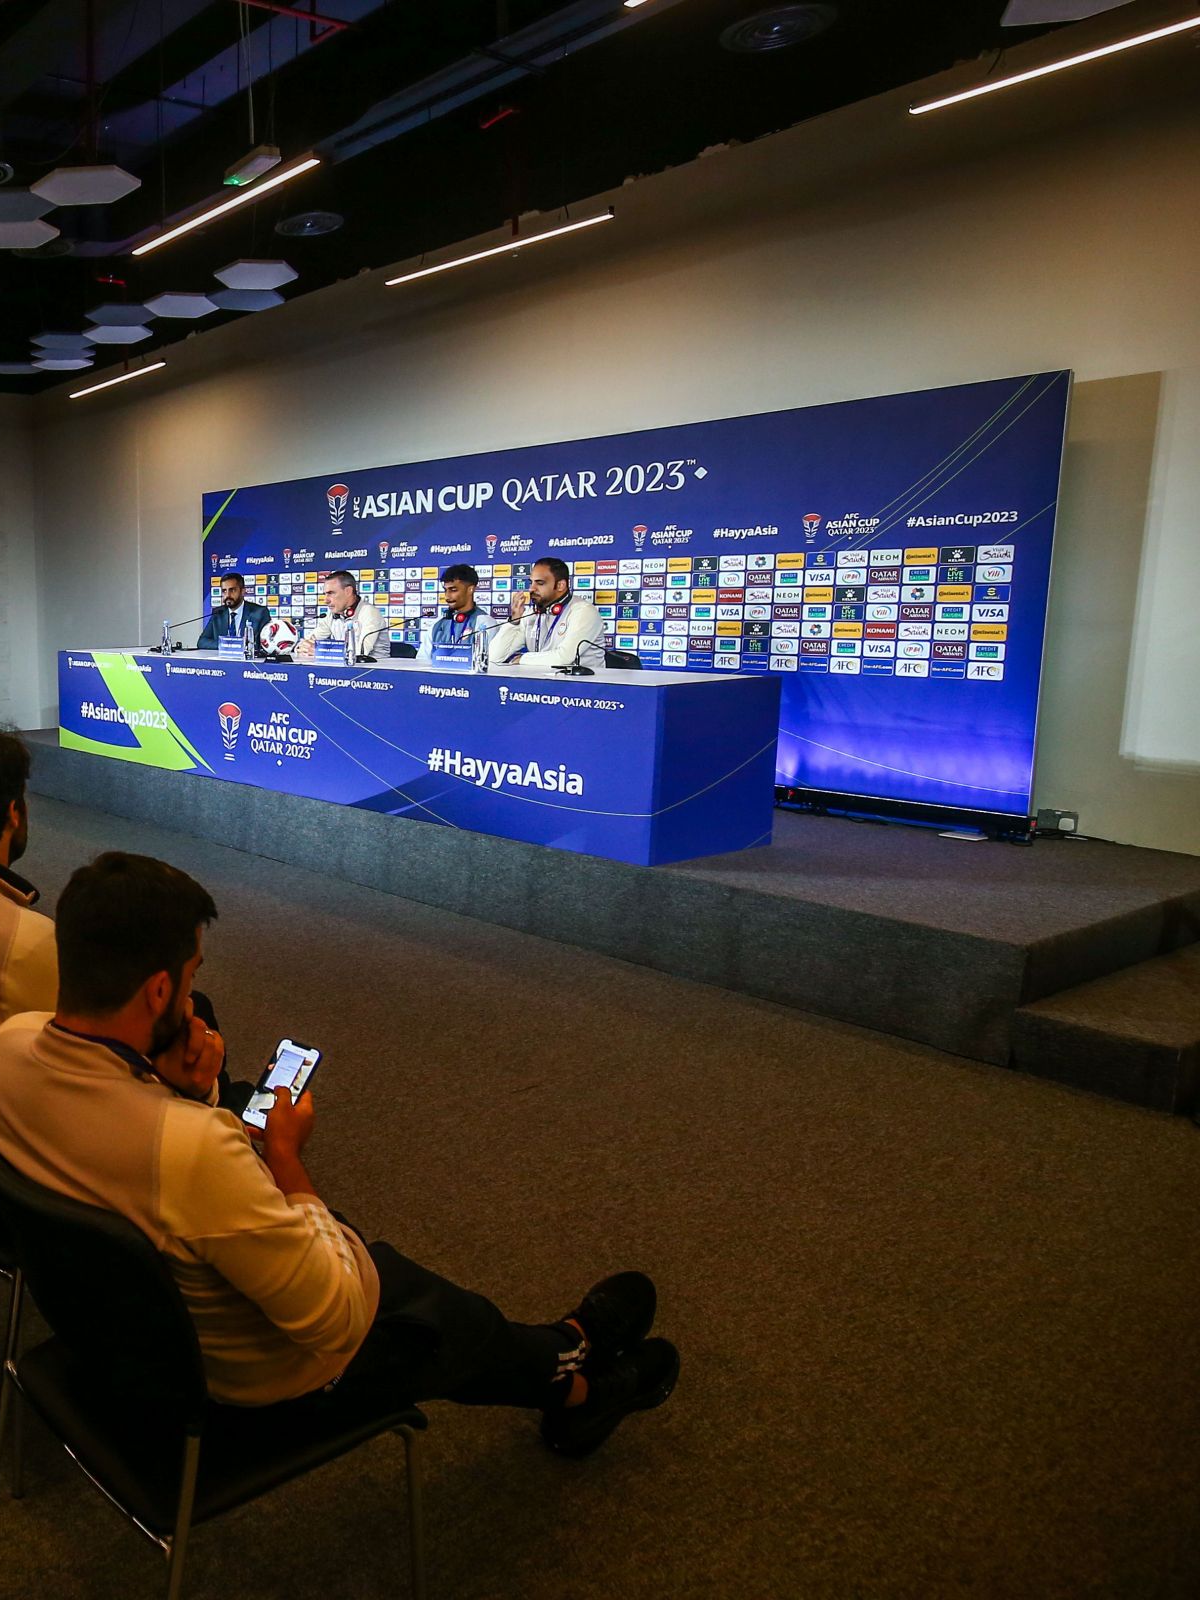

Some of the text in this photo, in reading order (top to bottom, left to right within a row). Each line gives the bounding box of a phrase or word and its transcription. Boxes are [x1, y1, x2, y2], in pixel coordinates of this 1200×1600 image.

[361, 489, 433, 518] ASIAN
[438, 483, 493, 511] CUP
[502, 471, 597, 510] QATAR
[605, 460, 685, 495] 2023
[826, 518, 879, 529] ASIAN CUP
[907, 511, 1018, 528] #AsianCup2023
[714, 525, 778, 540] #HayyaAsia
[828, 528, 853, 536] QATAR
[549, 535, 613, 547] #AsianCup2023
[431, 544, 471, 554] #HayyaAsia
[325, 549, 367, 560] #AsianCup2023
[246, 556, 274, 564] #HayyaAsia
[809, 573, 830, 581] VISA
[903, 607, 930, 615] QATAR
[977, 609, 1004, 617] VISA
[868, 645, 891, 653] VISA
[666, 655, 680, 663] AFC
[716, 657, 733, 665] AFC
[772, 659, 792, 668] AFC
[832, 661, 854, 670] AFC
[898, 663, 922, 673] AFC
[970, 666, 996, 676] AFC
[243, 671, 288, 682] #AsianCup2023
[351, 680, 371, 689] QATAR
[419, 685, 469, 698] #HayyaAsia
[513, 694, 617, 710] ASIAN CUP QATAR 2023
[81, 702, 168, 730] #AsianCup2023
[270, 712, 289, 725] AFC
[248, 723, 317, 745] ASIAN CUP
[251, 739, 311, 759] QATAR 2023
[428, 748, 584, 795] #HayyaAsia
